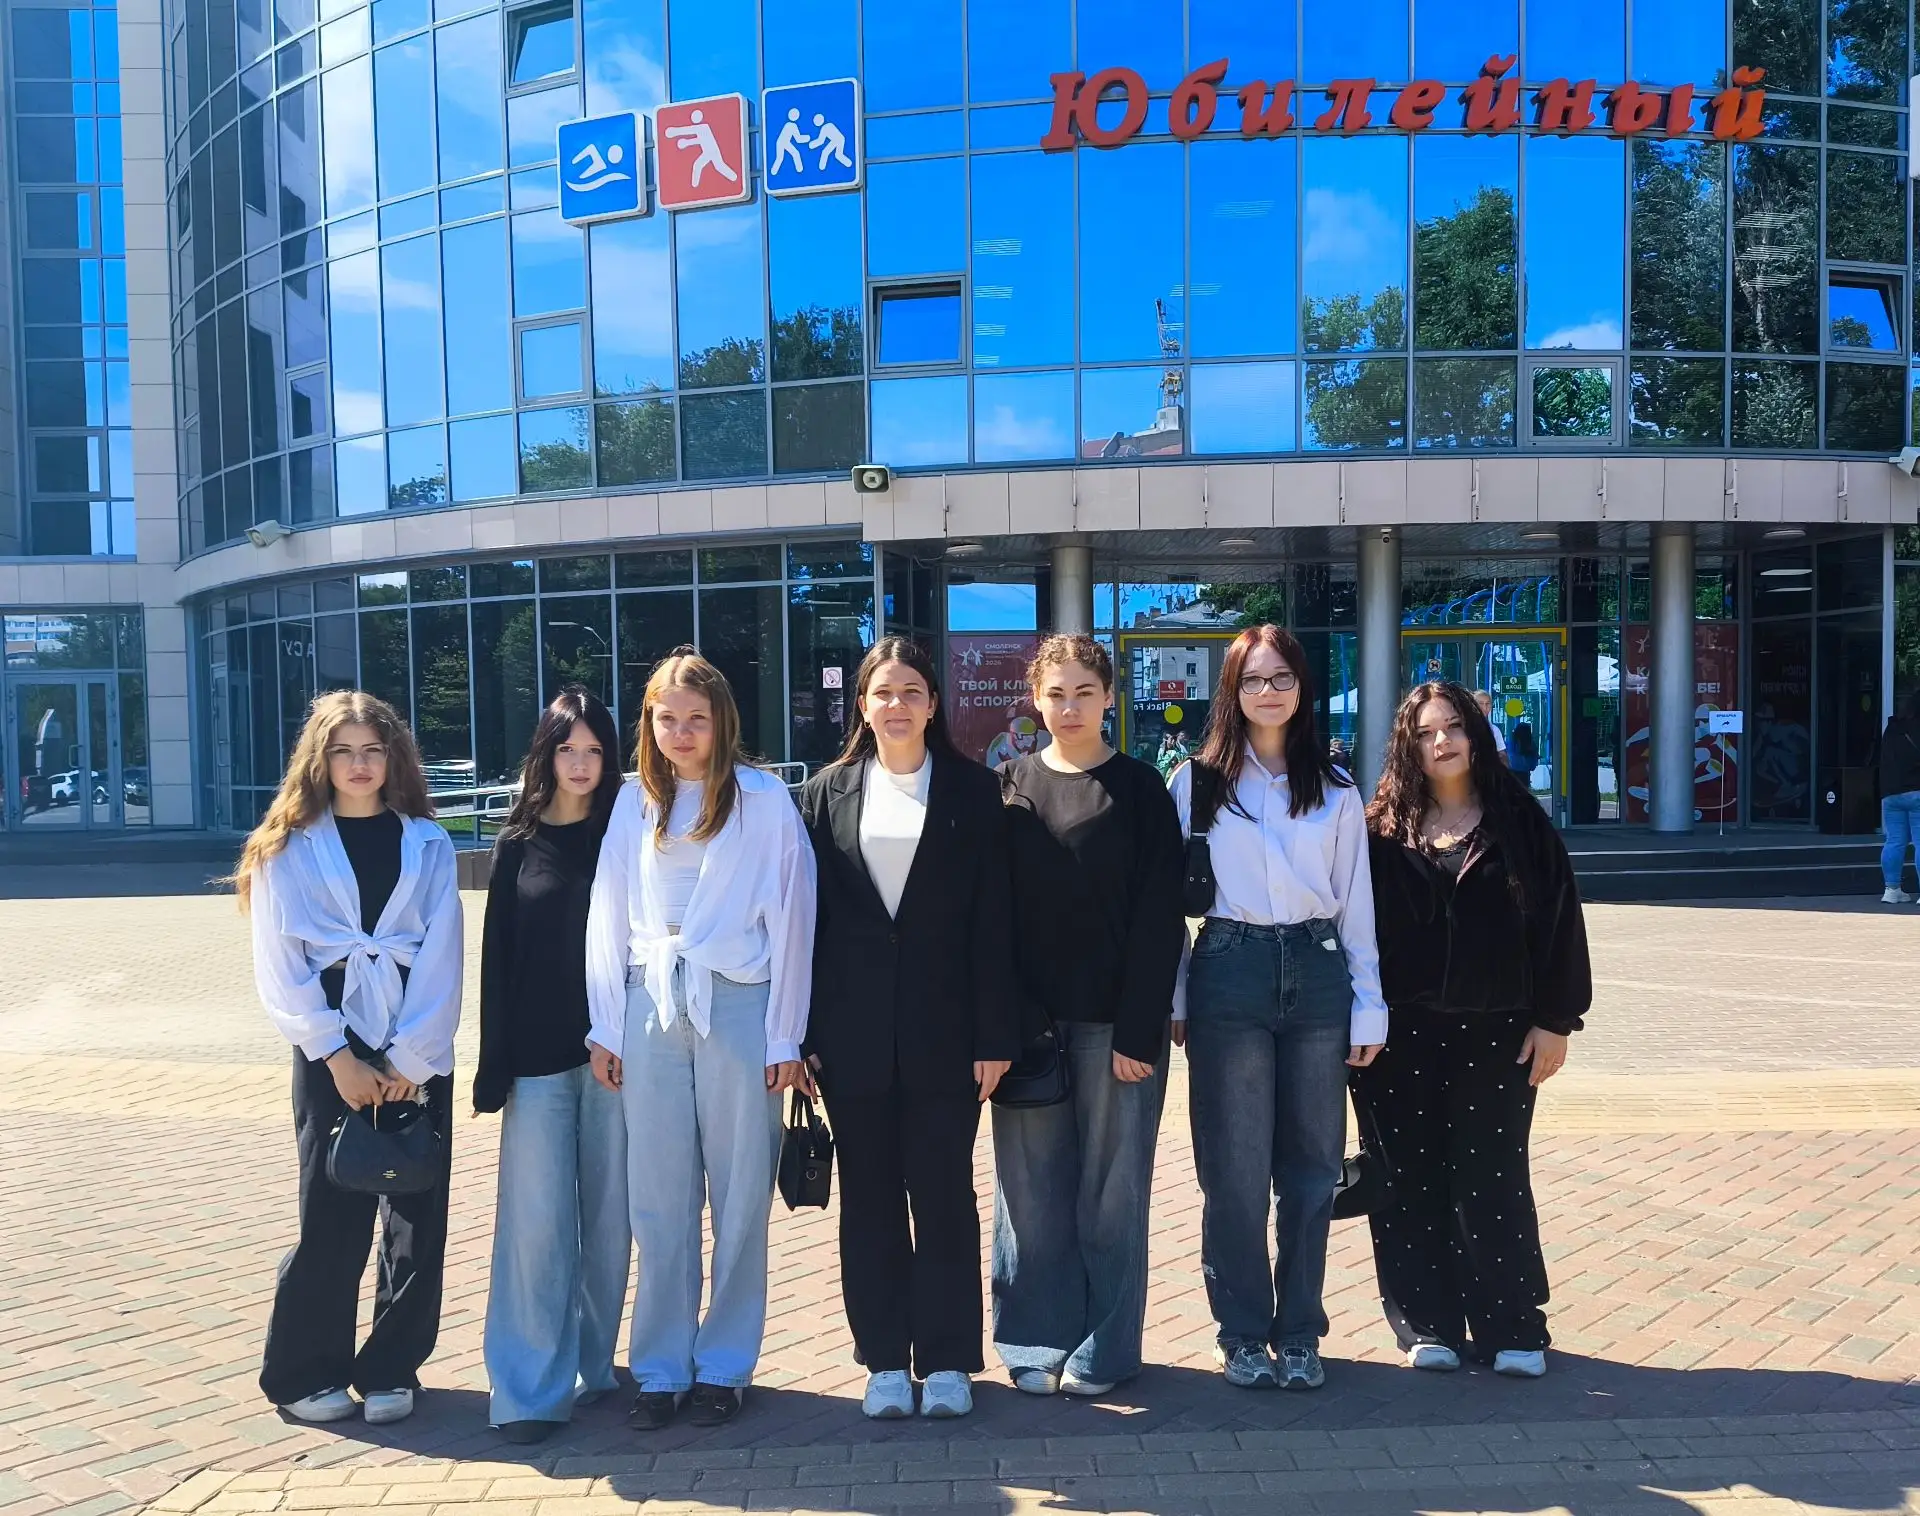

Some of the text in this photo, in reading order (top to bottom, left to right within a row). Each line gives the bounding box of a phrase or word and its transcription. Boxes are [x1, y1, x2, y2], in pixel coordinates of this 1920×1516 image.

[1040, 54, 1765, 152] Юбилейный
[958, 677, 998, 691] ТВОЙ
[1697, 682, 1721, 694] БЕ!
[959, 696, 969, 707] К
